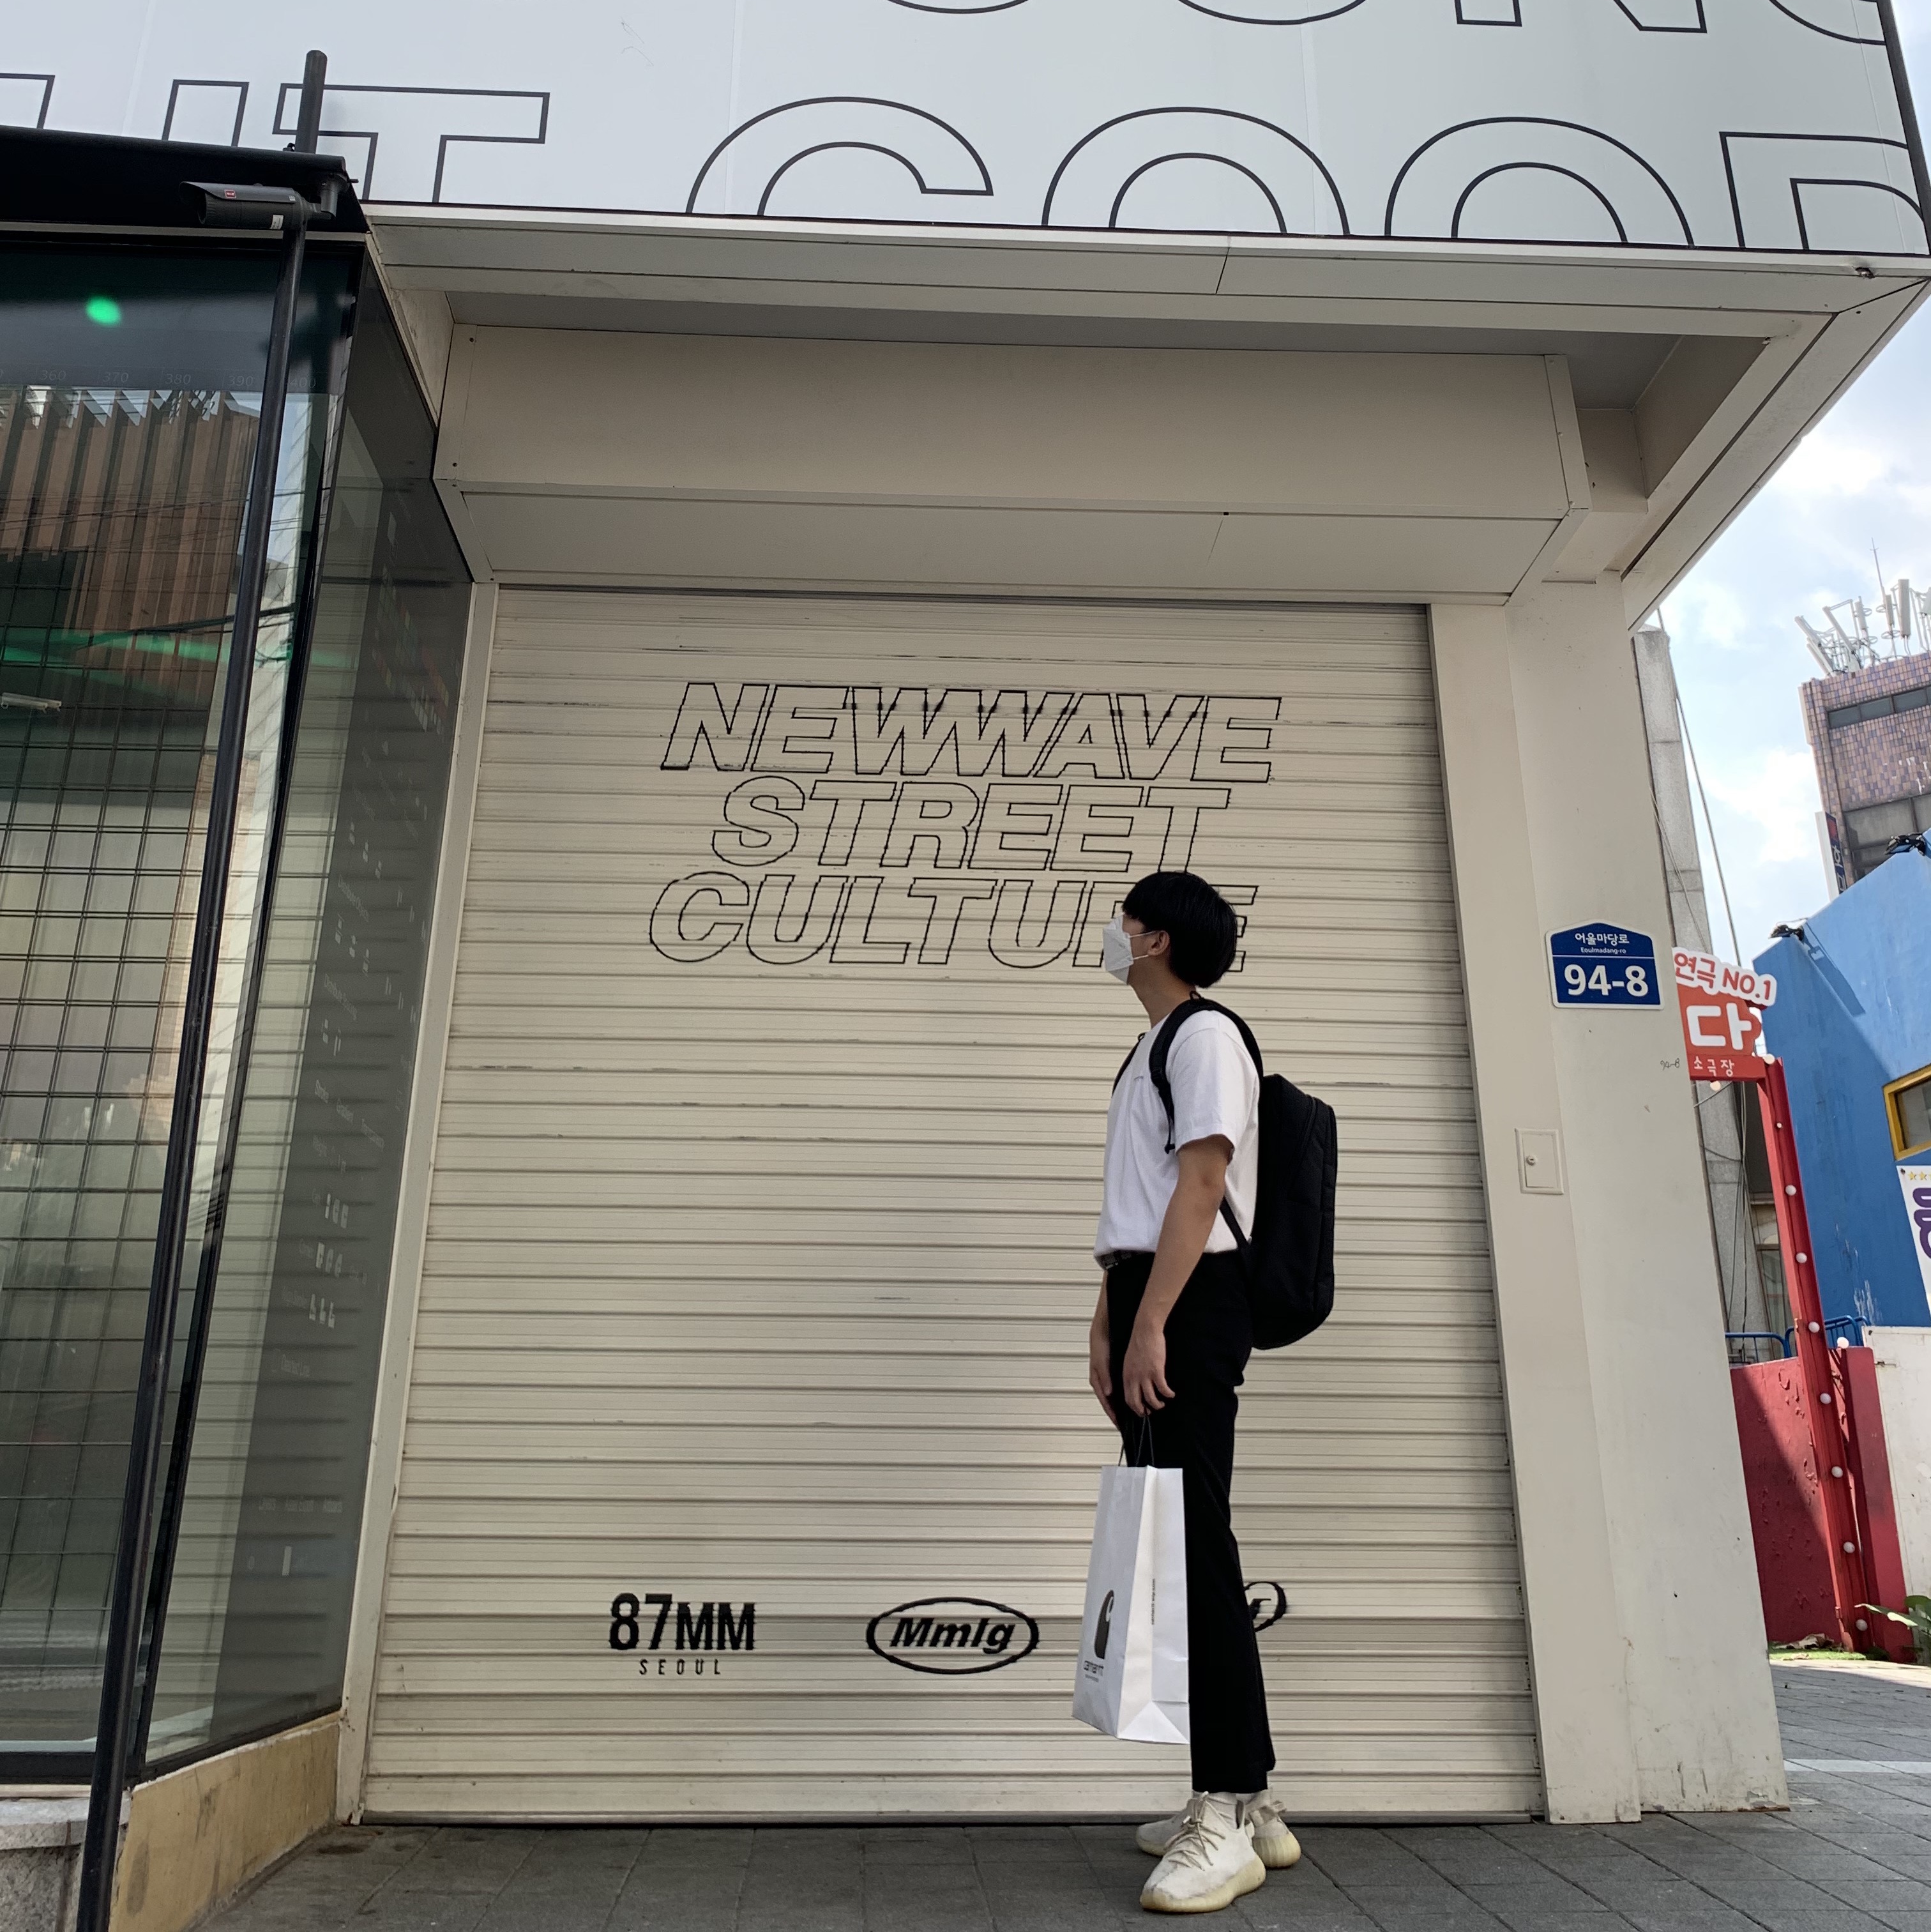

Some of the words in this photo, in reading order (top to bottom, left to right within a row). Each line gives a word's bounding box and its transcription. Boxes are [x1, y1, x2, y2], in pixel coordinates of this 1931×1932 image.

[40, 370, 66, 381] 360
[102, 372, 128, 383] 370
[165, 373, 191, 385] 380
[227, 375, 254, 386] 390
[712, 775, 1231, 872] STREET
[1575, 932, 1630, 946] 어울마당로
[1564, 964, 1649, 997] 94-8
[1674, 952, 1716, 989] 연극
[1722, 968, 1771, 1001] NO.1
[1686, 1002, 1752, 1051] 다
[1693, 1055, 1735, 1077] 소극장
[609, 1592, 756, 1650] 87MM
[890, 1617, 1016, 1654] Mmlg
[639, 1658, 721, 1675] SEOUL
